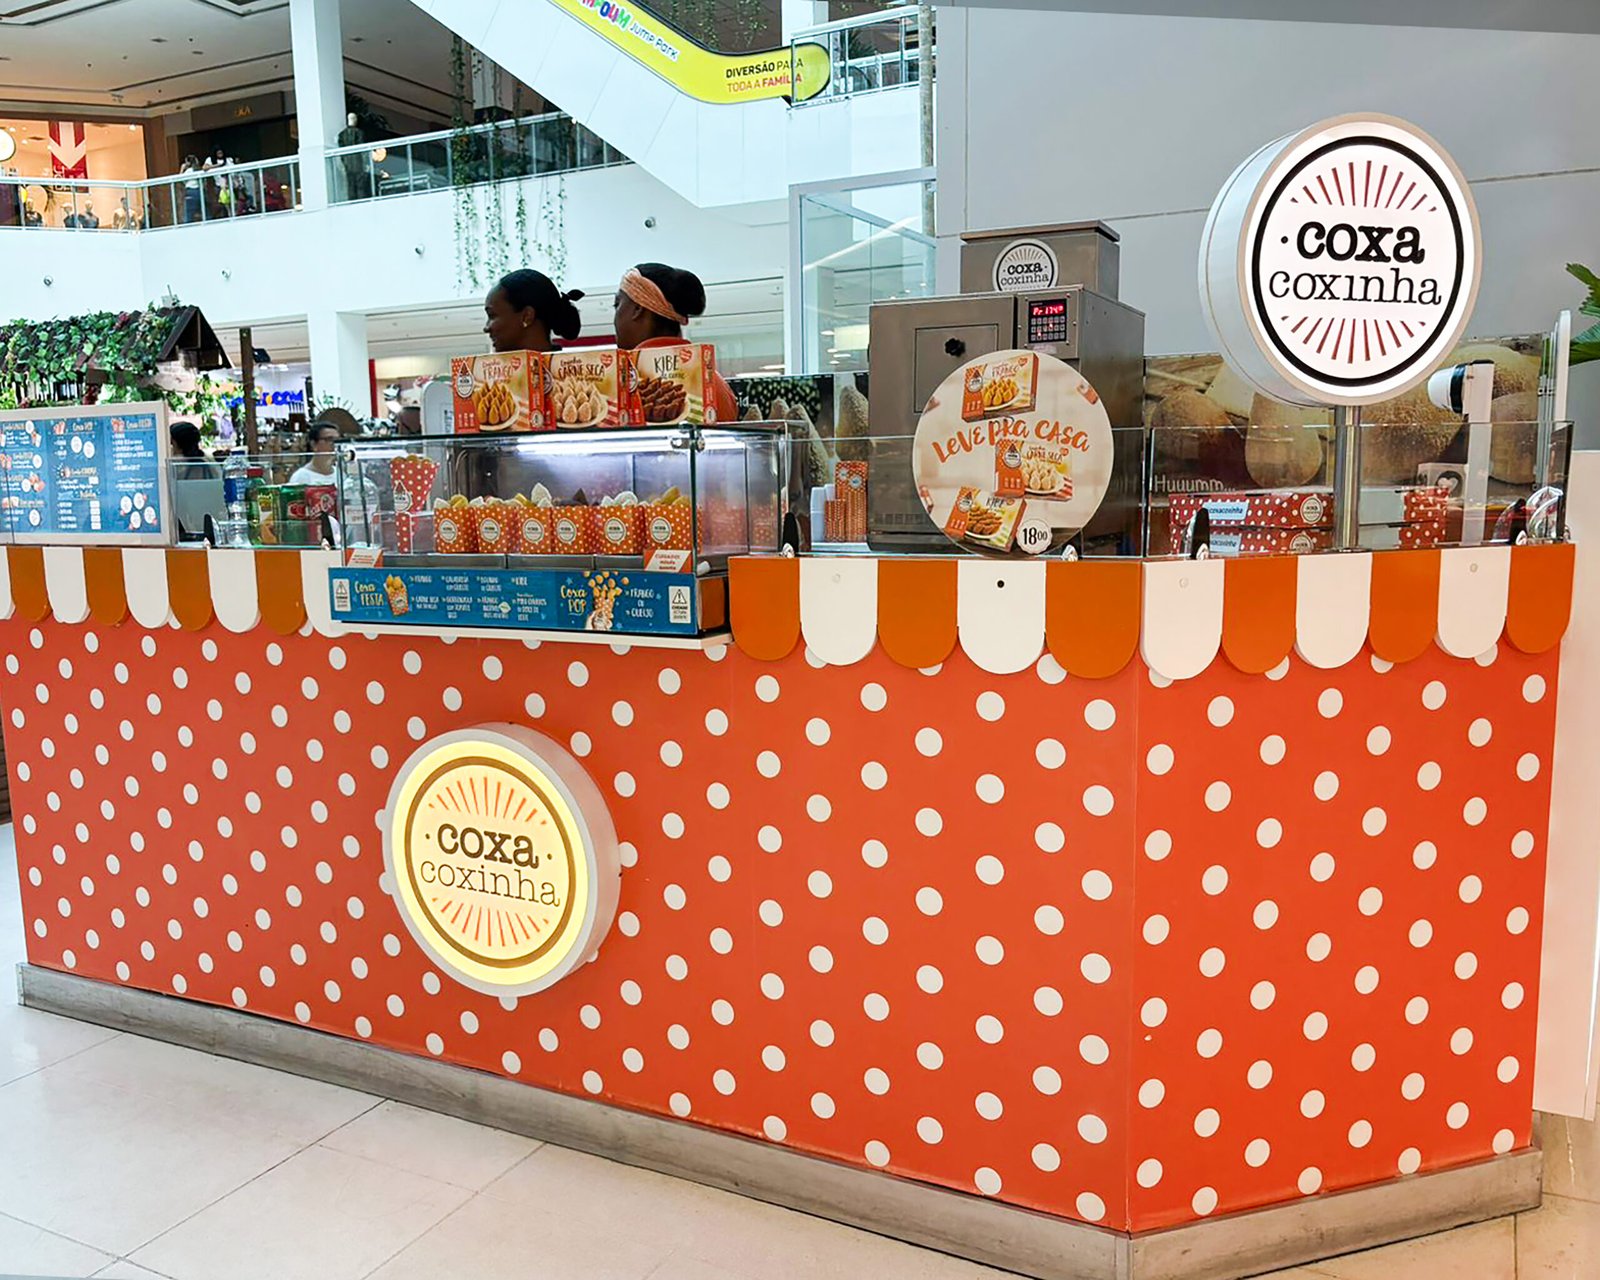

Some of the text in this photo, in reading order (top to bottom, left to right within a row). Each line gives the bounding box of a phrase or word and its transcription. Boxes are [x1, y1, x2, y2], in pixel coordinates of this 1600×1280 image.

[630, 23, 655, 41] Jump
[656, 38, 678, 59] Park
[726, 58, 803, 78] DIVERSÃO PAA
[727, 73, 802, 93] TODA A FAMÍLA
[1297, 221, 1425, 264] coxa
[1007, 262, 1043, 275] coxa
[1001, 272, 1049, 286] coxinha
[1269, 267, 1442, 305] coxinha
[586, 364, 606, 377] SECA
[654, 355, 680, 373] KIBE
[360, 593, 384, 606] FESTA
[630, 588, 655, 598] FRANGO
[568, 599, 587, 613] POP
[437, 823, 539, 869] coxa
[420, 860, 561, 907] coxinha
